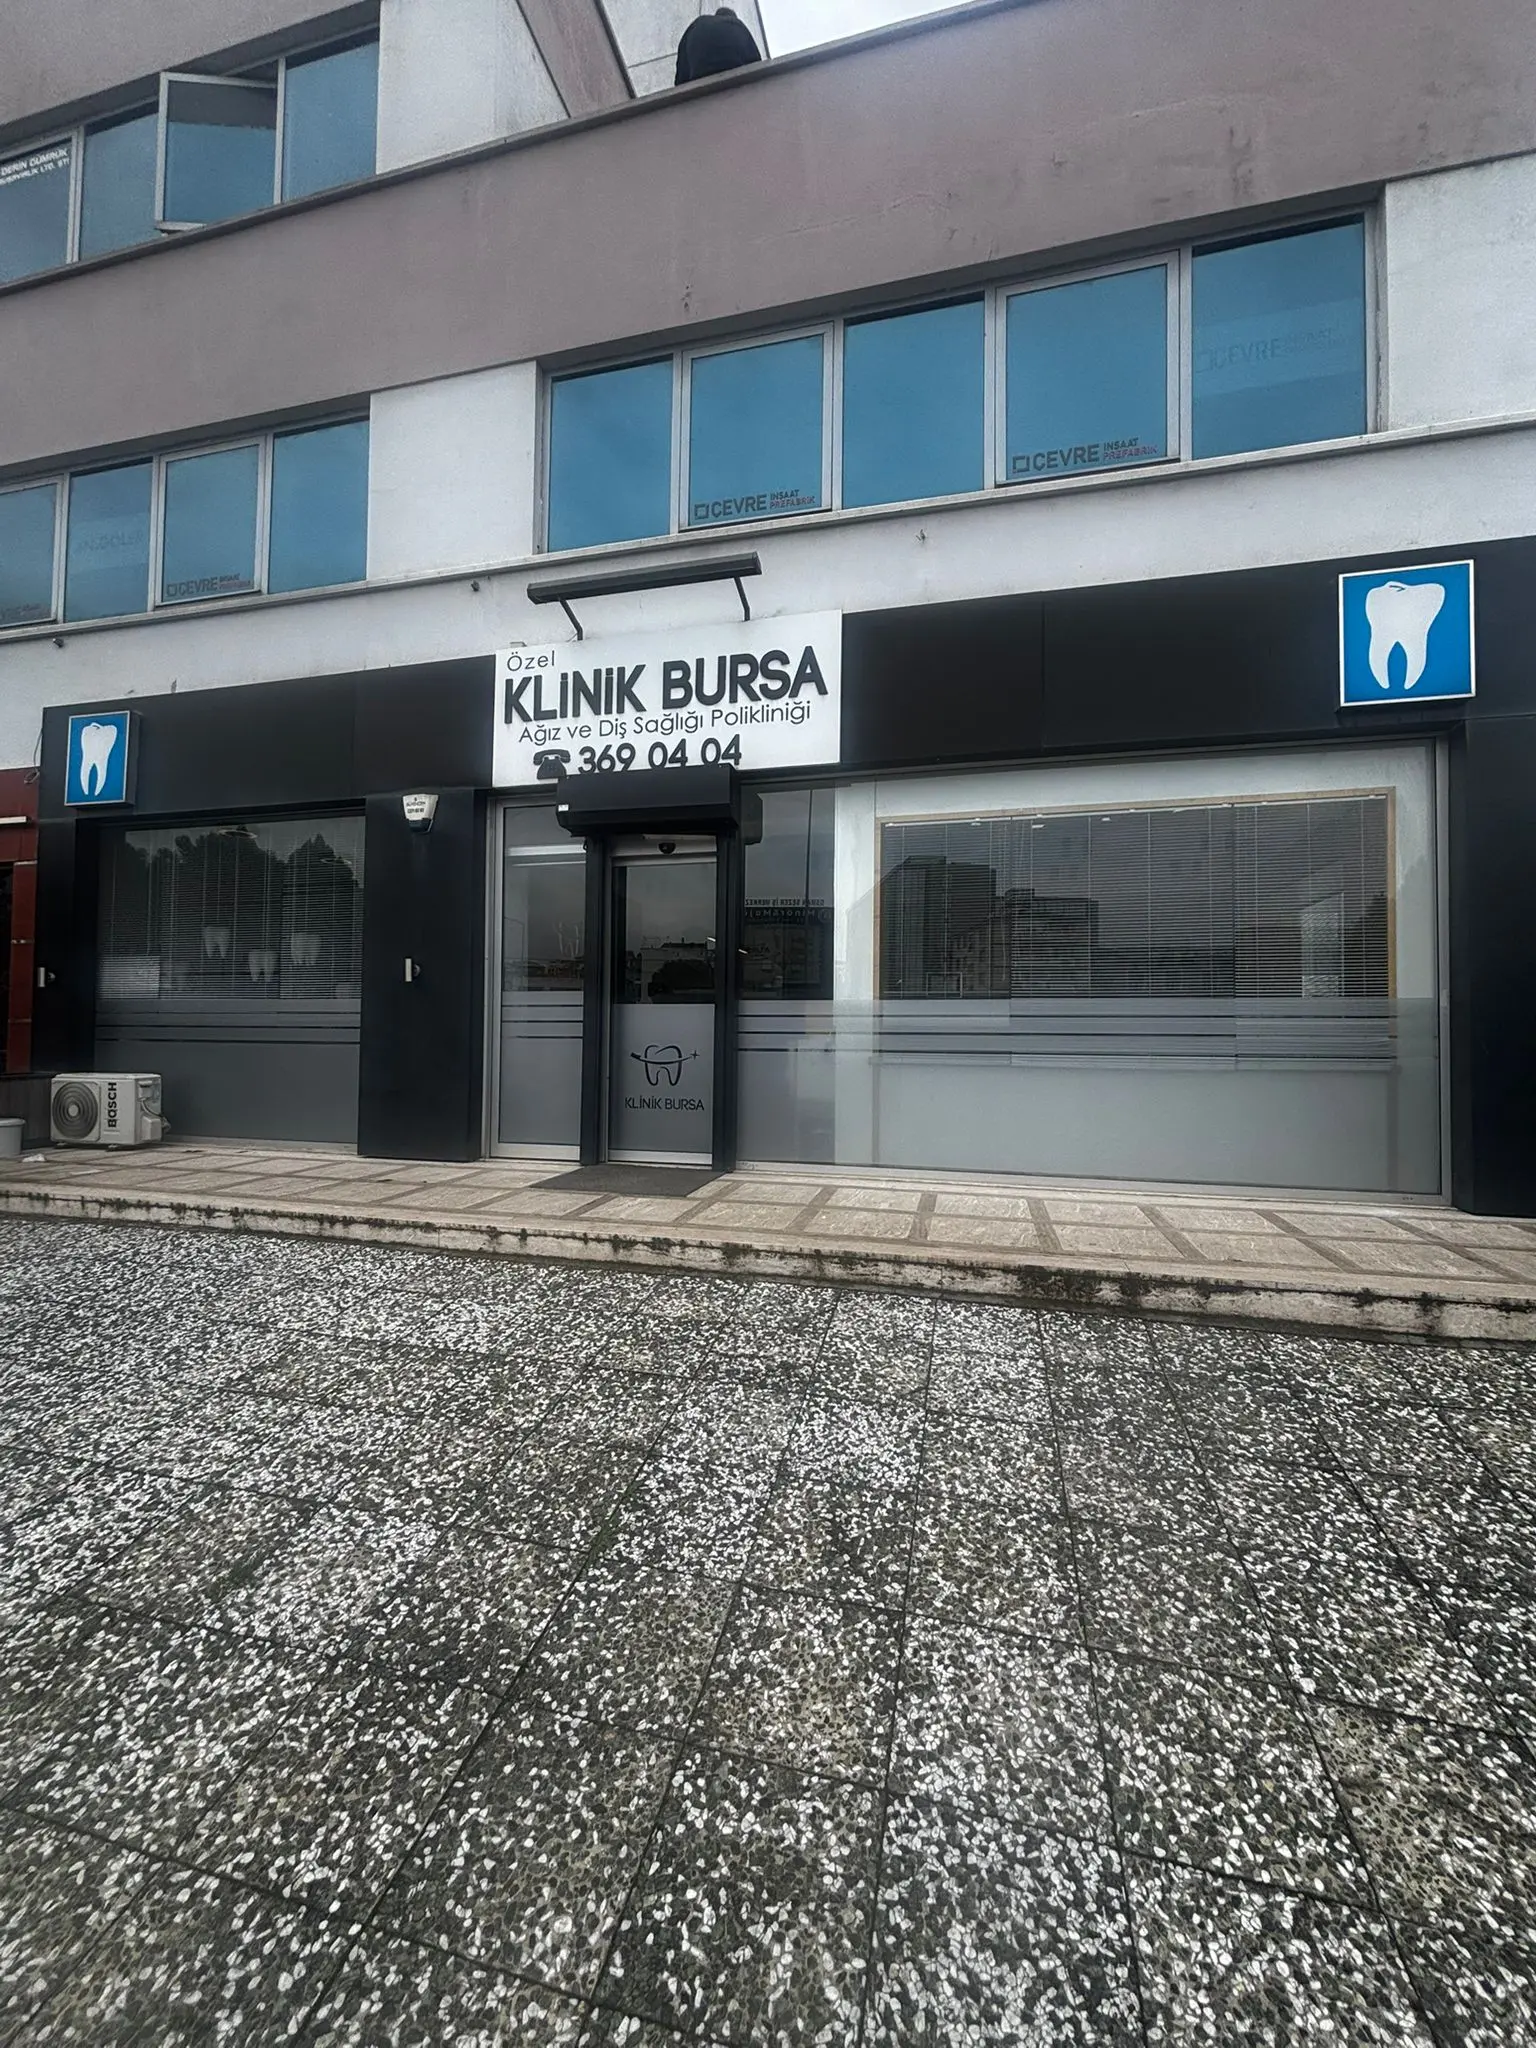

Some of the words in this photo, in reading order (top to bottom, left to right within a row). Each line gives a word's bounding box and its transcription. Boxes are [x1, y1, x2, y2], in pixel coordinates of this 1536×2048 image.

[506, 650, 555, 672] Özel
[661, 645, 829, 710] BURSA
[518, 724, 562, 746] Ağız
[569, 724, 592, 739] ve
[599, 718, 628, 739] Diş
[632, 711, 704, 735] Sağlığı
[711, 701, 812, 727] Polikliniği
[577, 742, 636, 774] 369
[648, 738, 689, 769] 04
[701, 733, 742, 766] 04
[107, 1082, 117, 1128] BOSCH
[664, 1098, 705, 1111] BURSA
